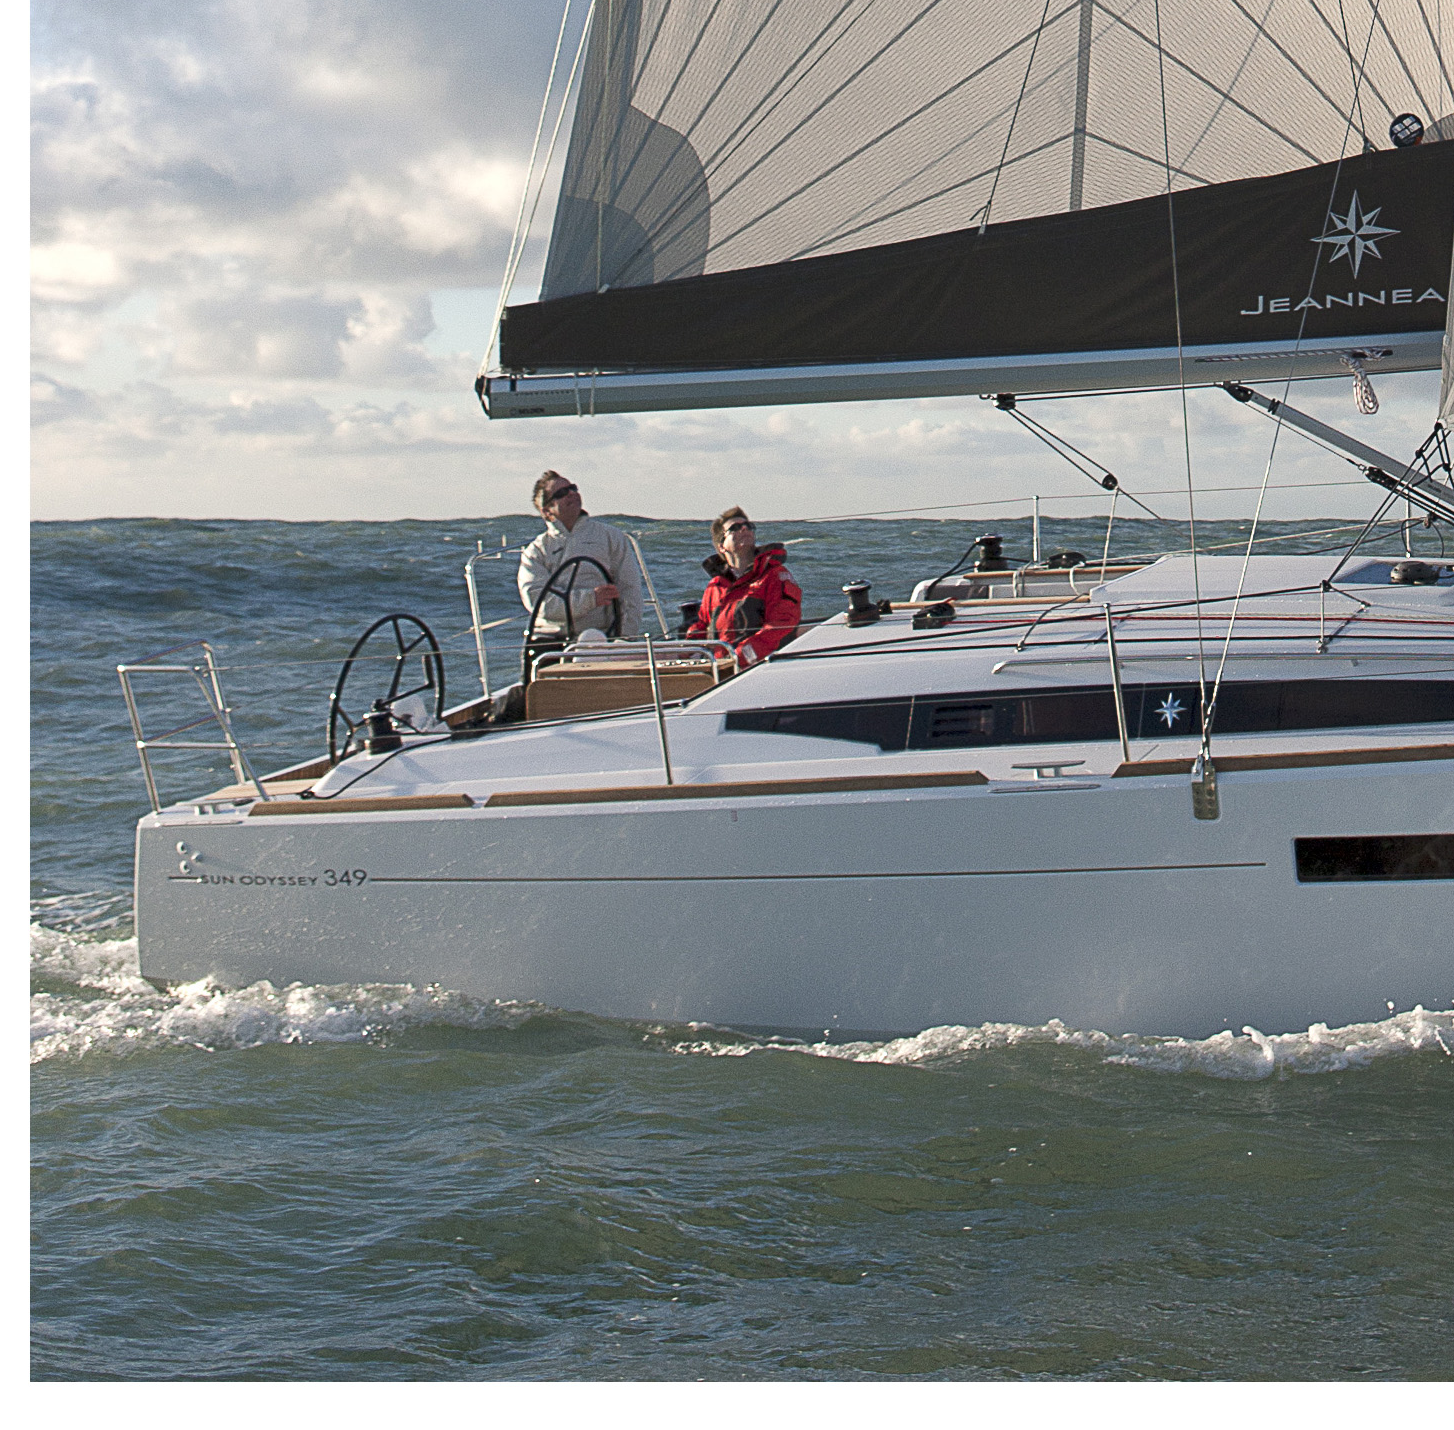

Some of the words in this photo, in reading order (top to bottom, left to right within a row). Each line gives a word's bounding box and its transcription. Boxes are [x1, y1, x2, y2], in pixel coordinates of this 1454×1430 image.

[1240, 287, 1446, 315] JEANNEA
[199, 874, 235, 885] SUN
[239, 875, 319, 887] ODYSSEY
[323, 869, 368, 887] 349
